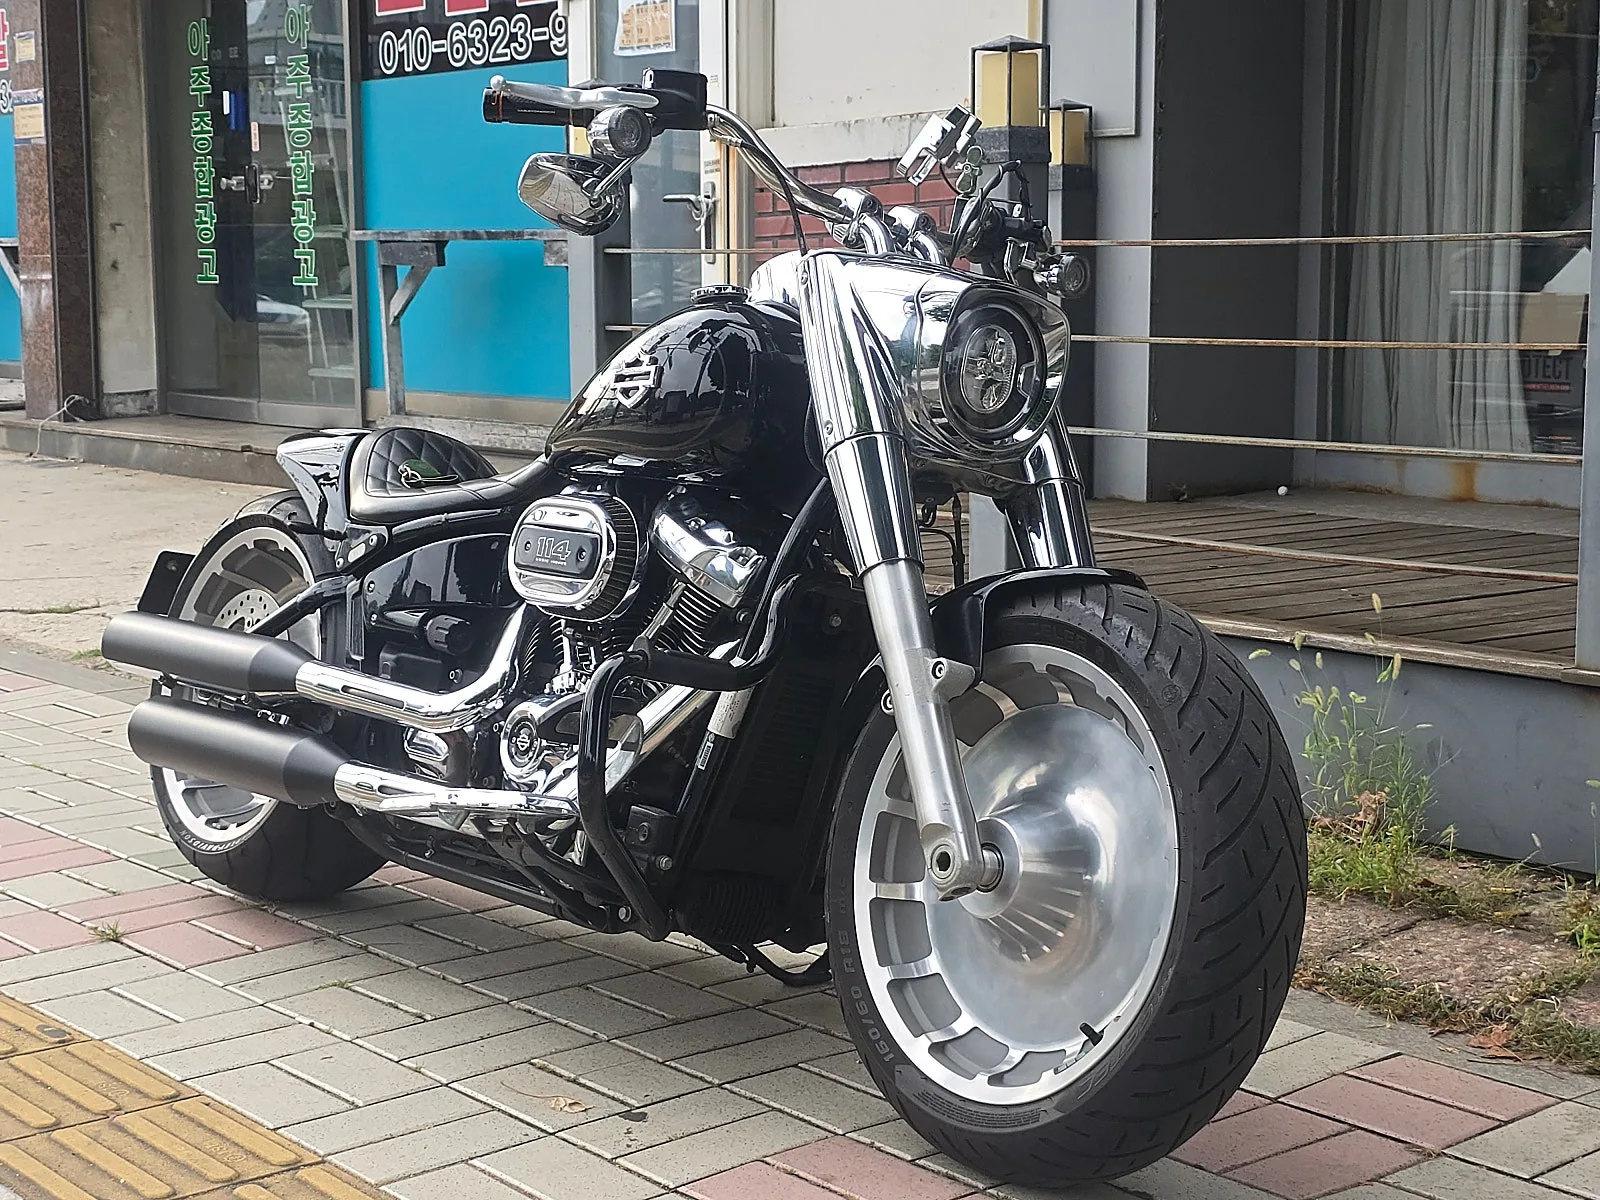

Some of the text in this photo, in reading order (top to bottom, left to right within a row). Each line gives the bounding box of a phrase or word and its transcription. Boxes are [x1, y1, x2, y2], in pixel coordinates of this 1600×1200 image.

[188, 18, 219, 284] 아주종합광고
[285, 4, 318, 286] 아주종합광고
[536, 536, 571, 560] 114
[851, 986, 892, 1062] 160/60
